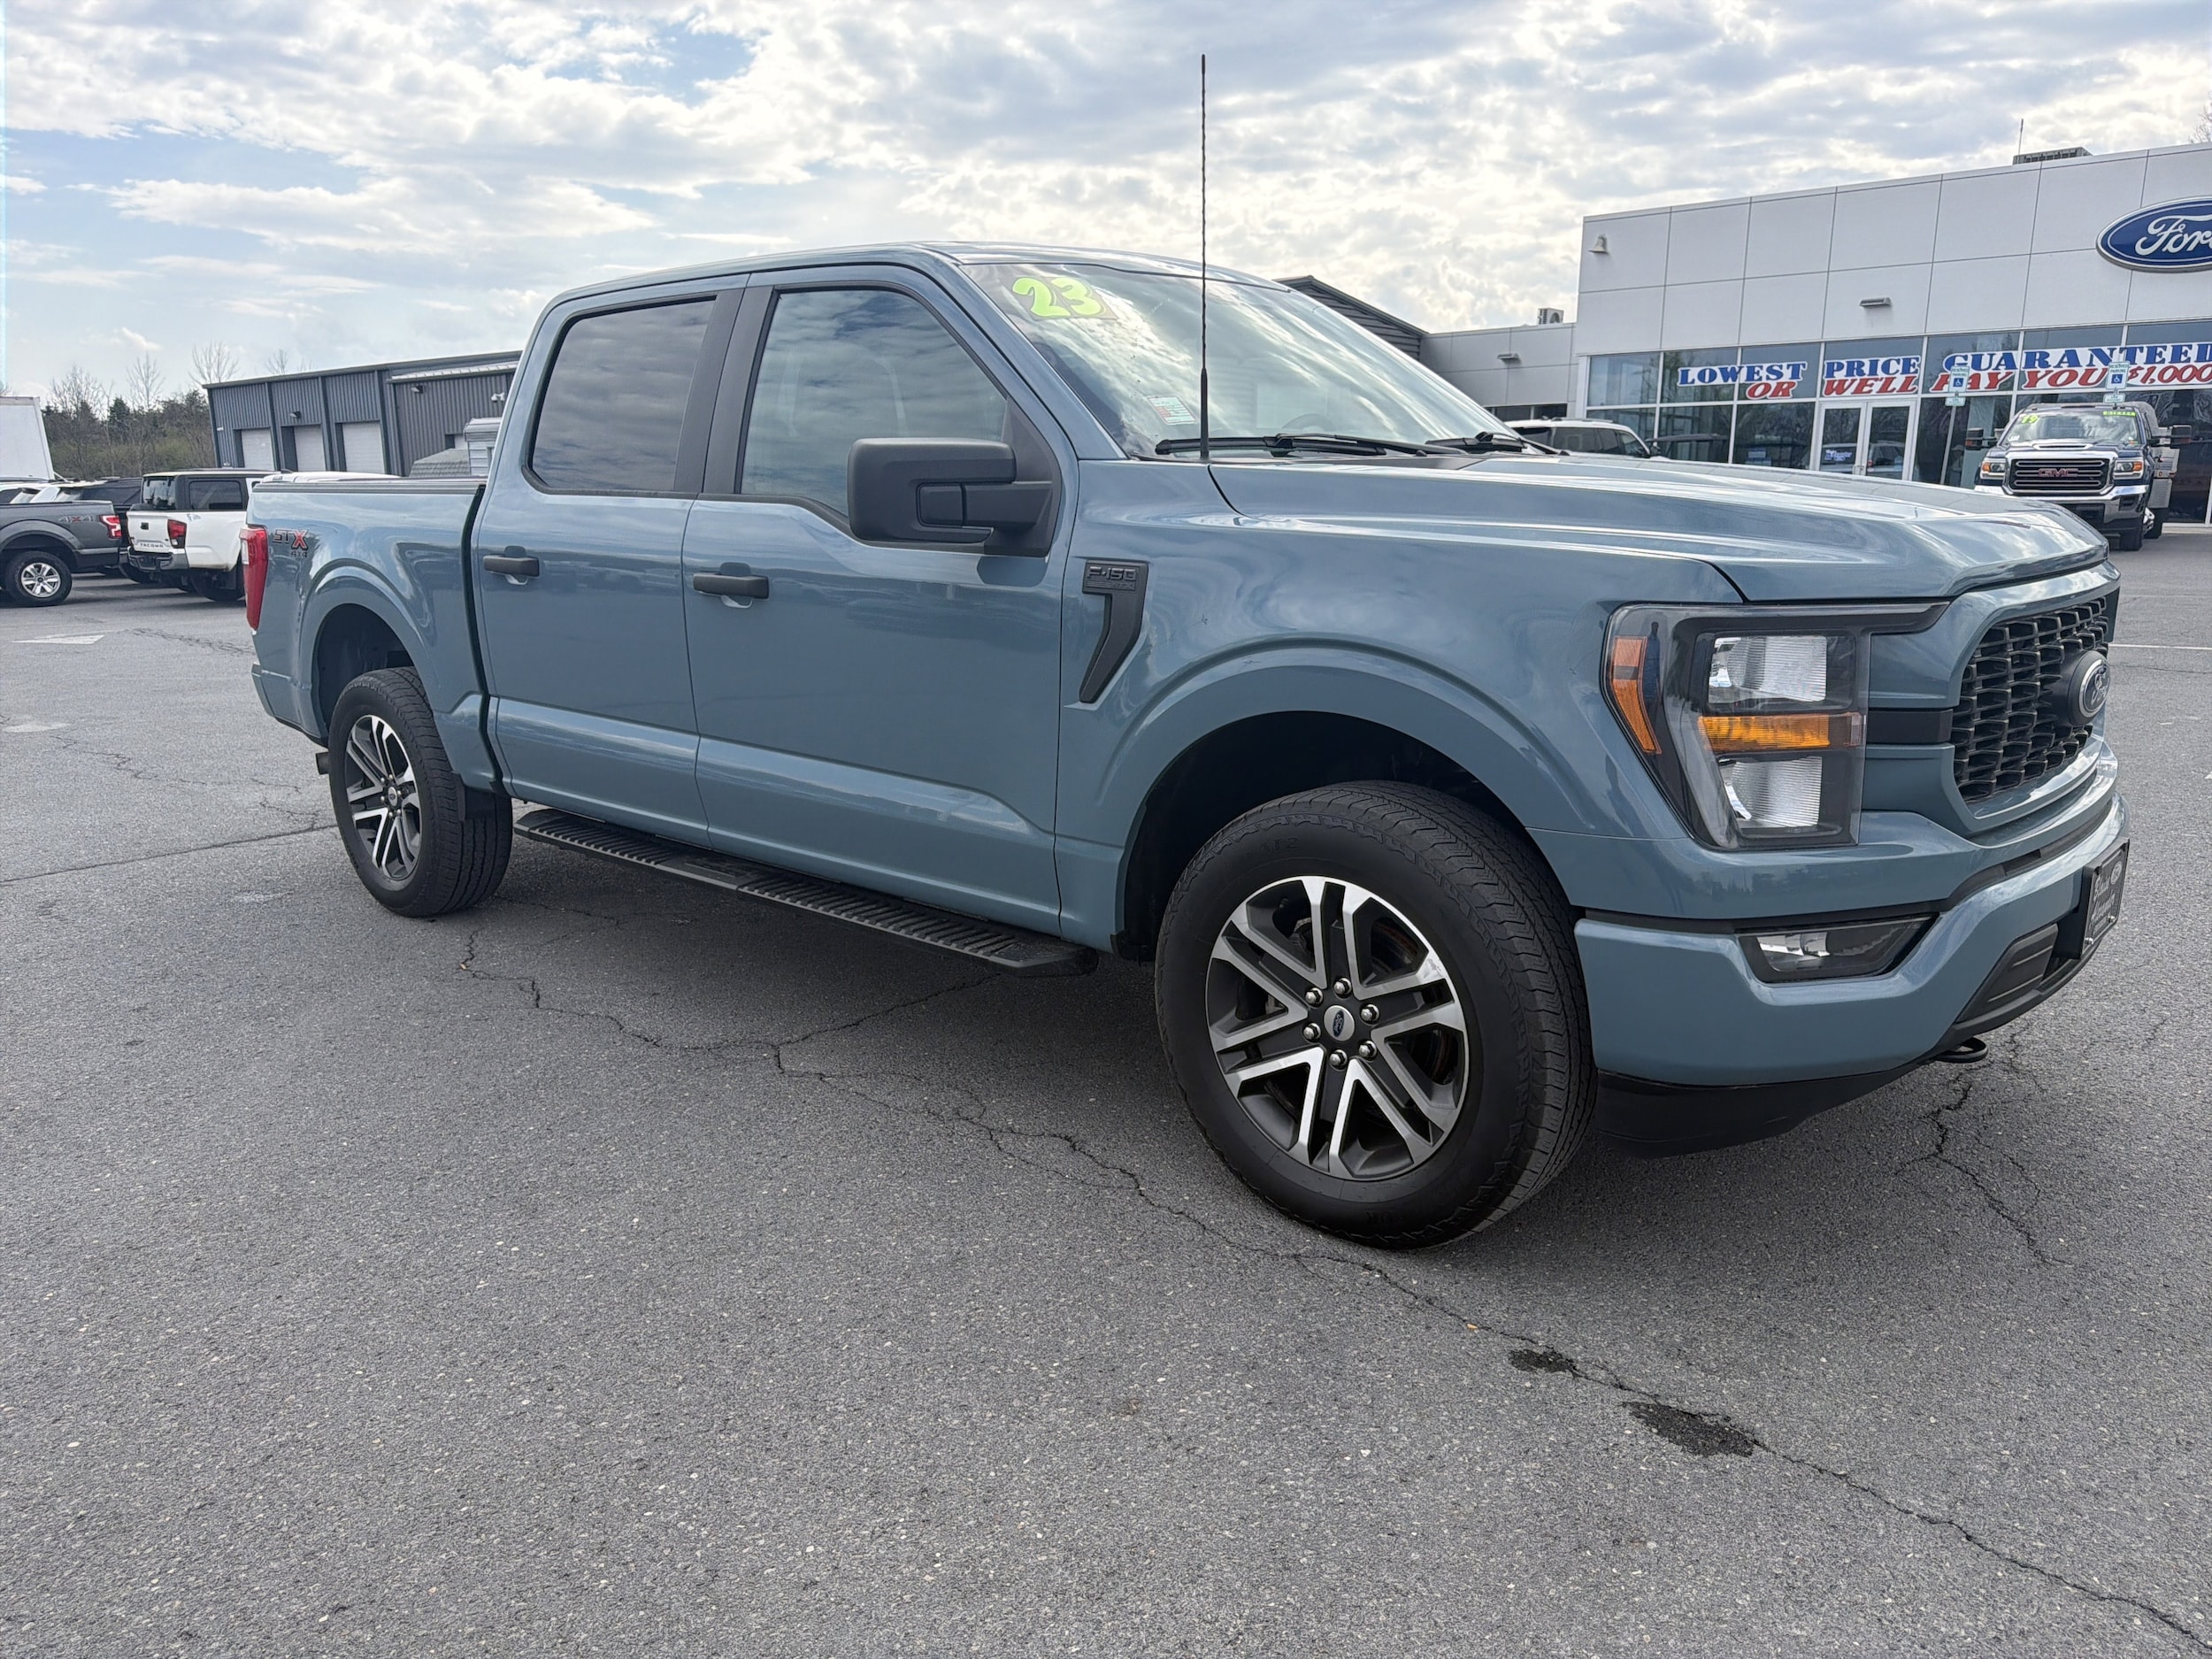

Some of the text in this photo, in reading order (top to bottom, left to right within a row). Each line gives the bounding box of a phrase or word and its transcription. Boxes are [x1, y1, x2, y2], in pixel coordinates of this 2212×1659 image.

[2135, 214, 2212, 256] For
[1012, 276, 1102, 317] 23
[1679, 363, 1807, 385] LOWEST
[1824, 357, 1920, 379] PRICE
[1747, 381, 1797, 398] OR
[1824, 376, 1918, 396] WE'LL
[2024, 368, 2108, 388] YOU
[2038, 468, 2078, 478] GMC
[273, 529, 309, 549] STX
[1087, 566, 1136, 580] F-150
